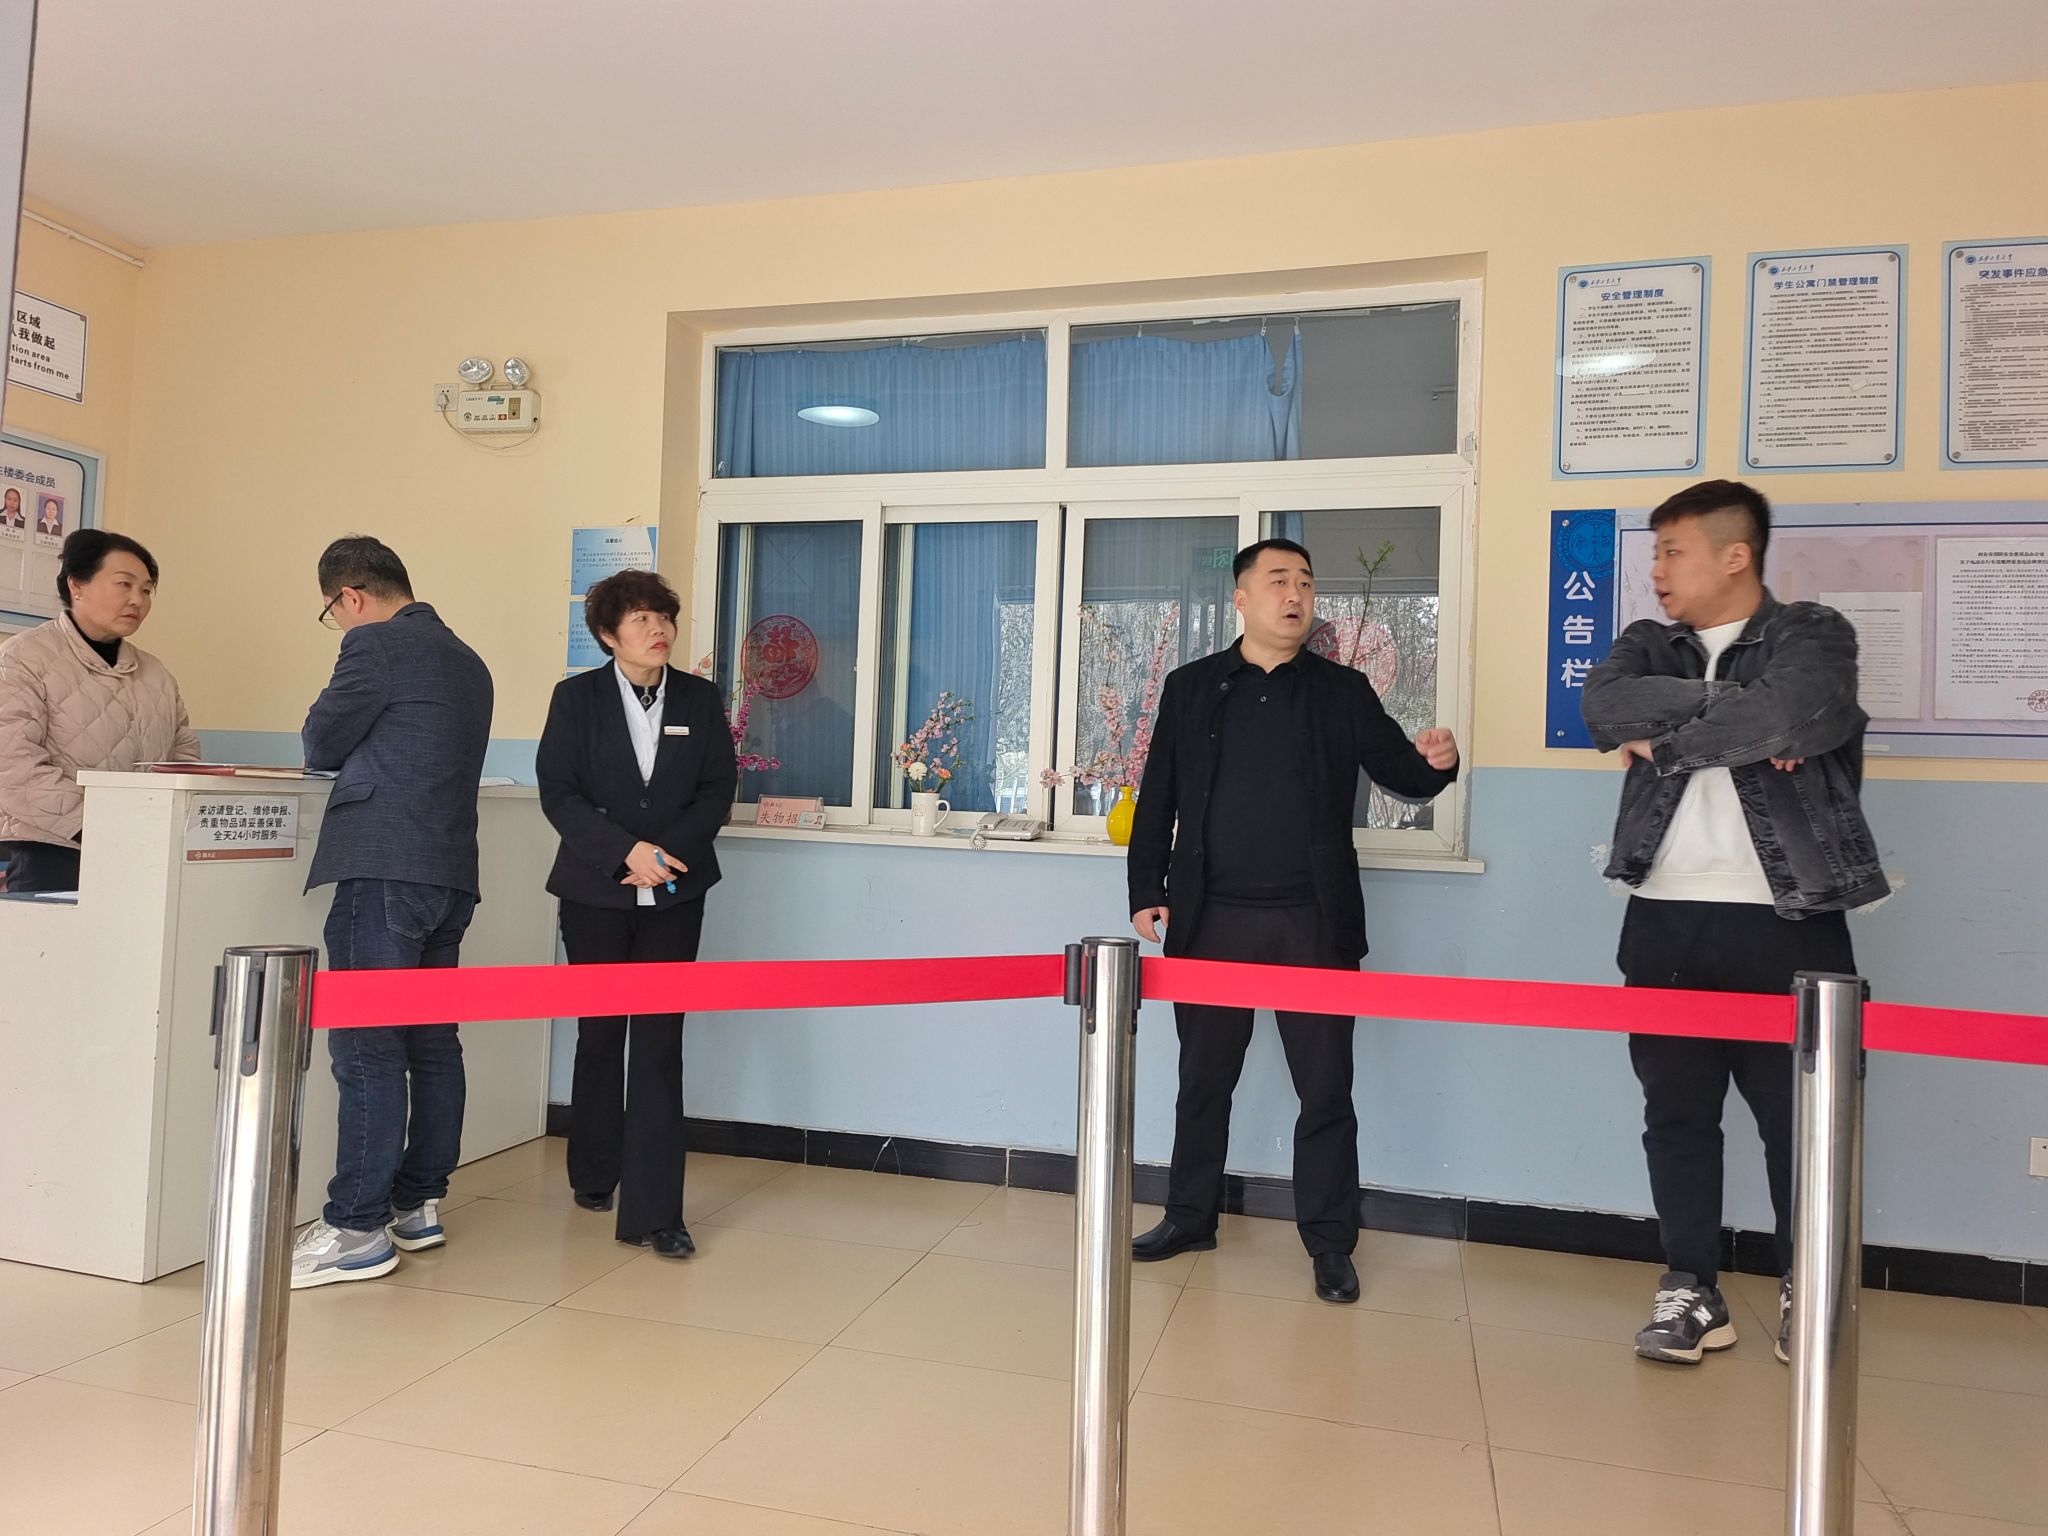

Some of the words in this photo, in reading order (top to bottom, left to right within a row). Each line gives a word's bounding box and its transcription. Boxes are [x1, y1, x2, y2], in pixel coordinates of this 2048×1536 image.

[1979, 267, 2048, 279] 突发事件应急
[1774, 276, 1879, 290] 学生公寓门禁管理制度
[1601, 288, 1664, 301] 安全管理制度
[17, 310, 41, 329] 区域
[32, 351, 51, 363] area
[33, 361, 54, 375] from
[56, 370, 70, 380] me
[1560, 571, 1597, 688] 公告栏
[213, 830, 278, 841] 全天24小时服务
